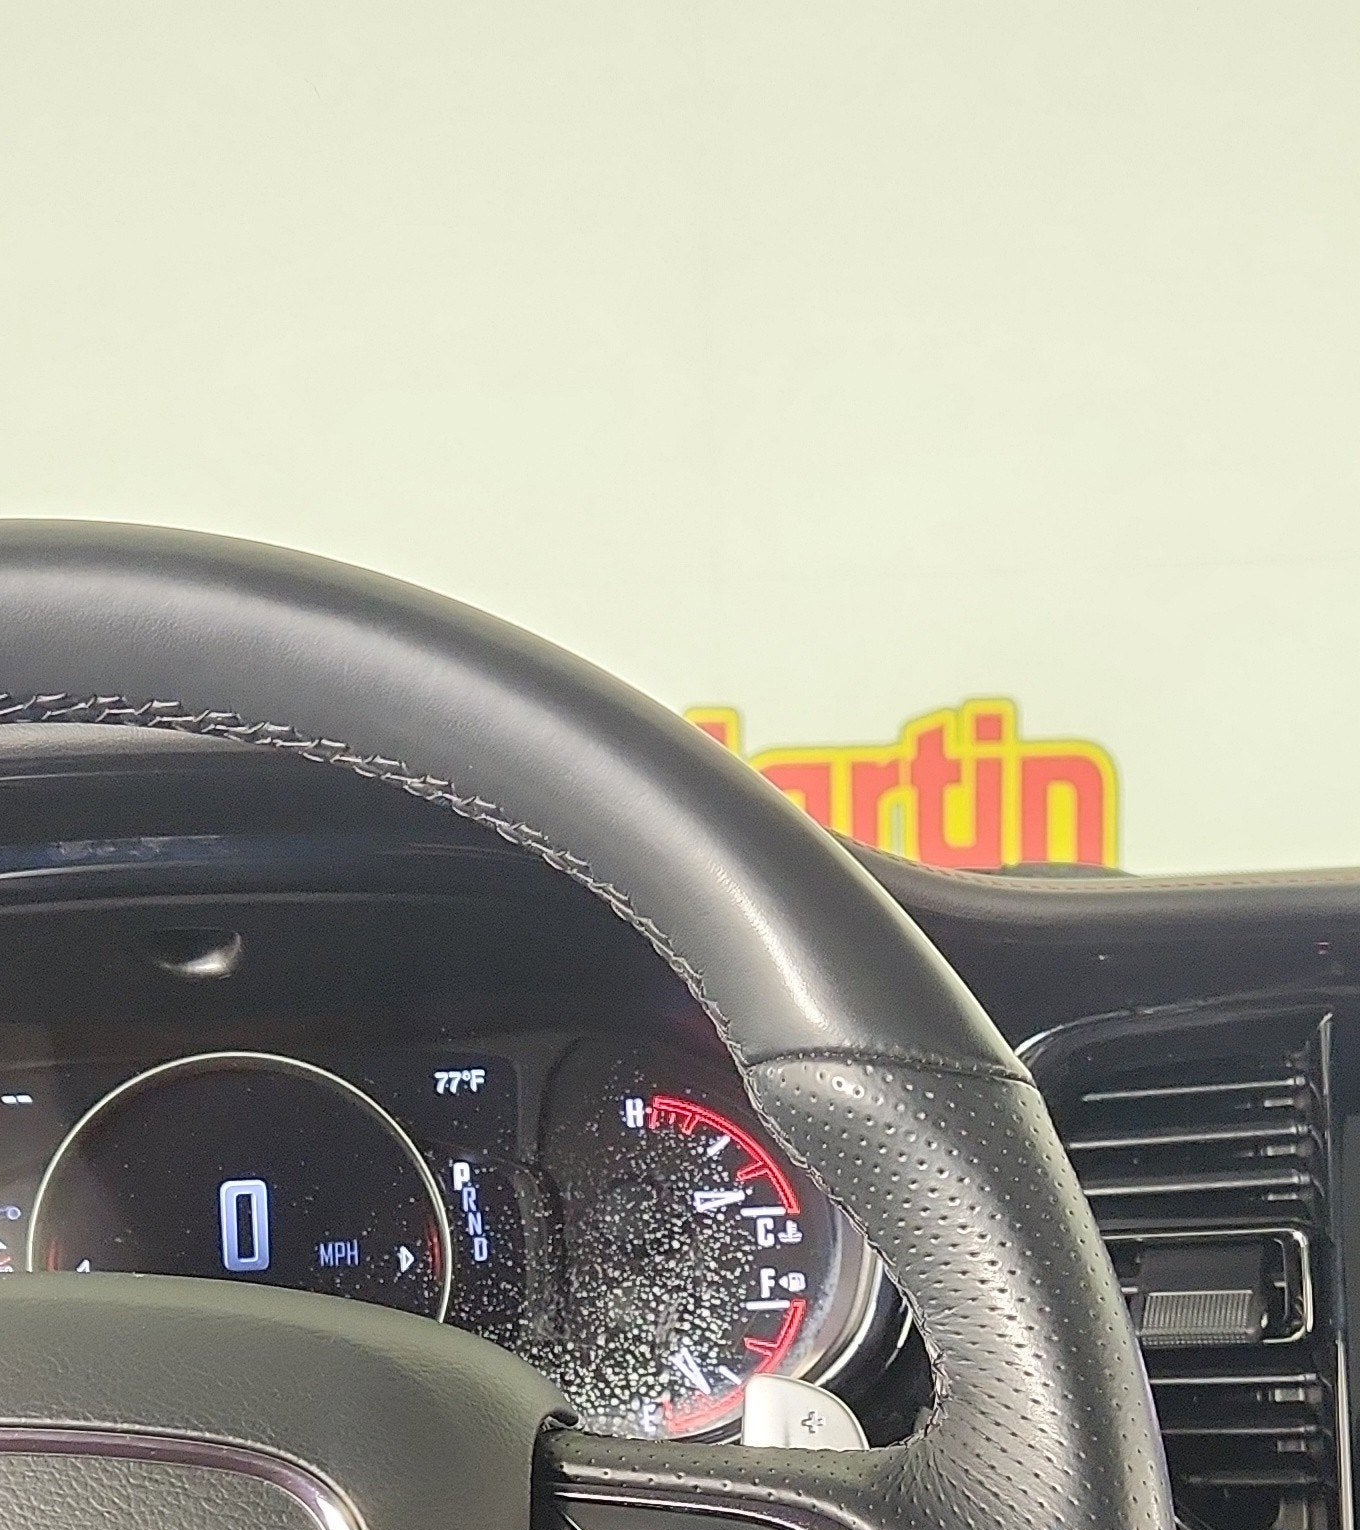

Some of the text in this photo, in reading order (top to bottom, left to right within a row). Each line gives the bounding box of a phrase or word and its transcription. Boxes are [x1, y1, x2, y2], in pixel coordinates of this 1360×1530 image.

[685, 697, 1120, 870] artin
[453, 1162, 470, 1191] P
[462, 1187, 477, 1212] R
[467, 1212, 481, 1237] N
[319, 1240, 359, 1267] MPH
